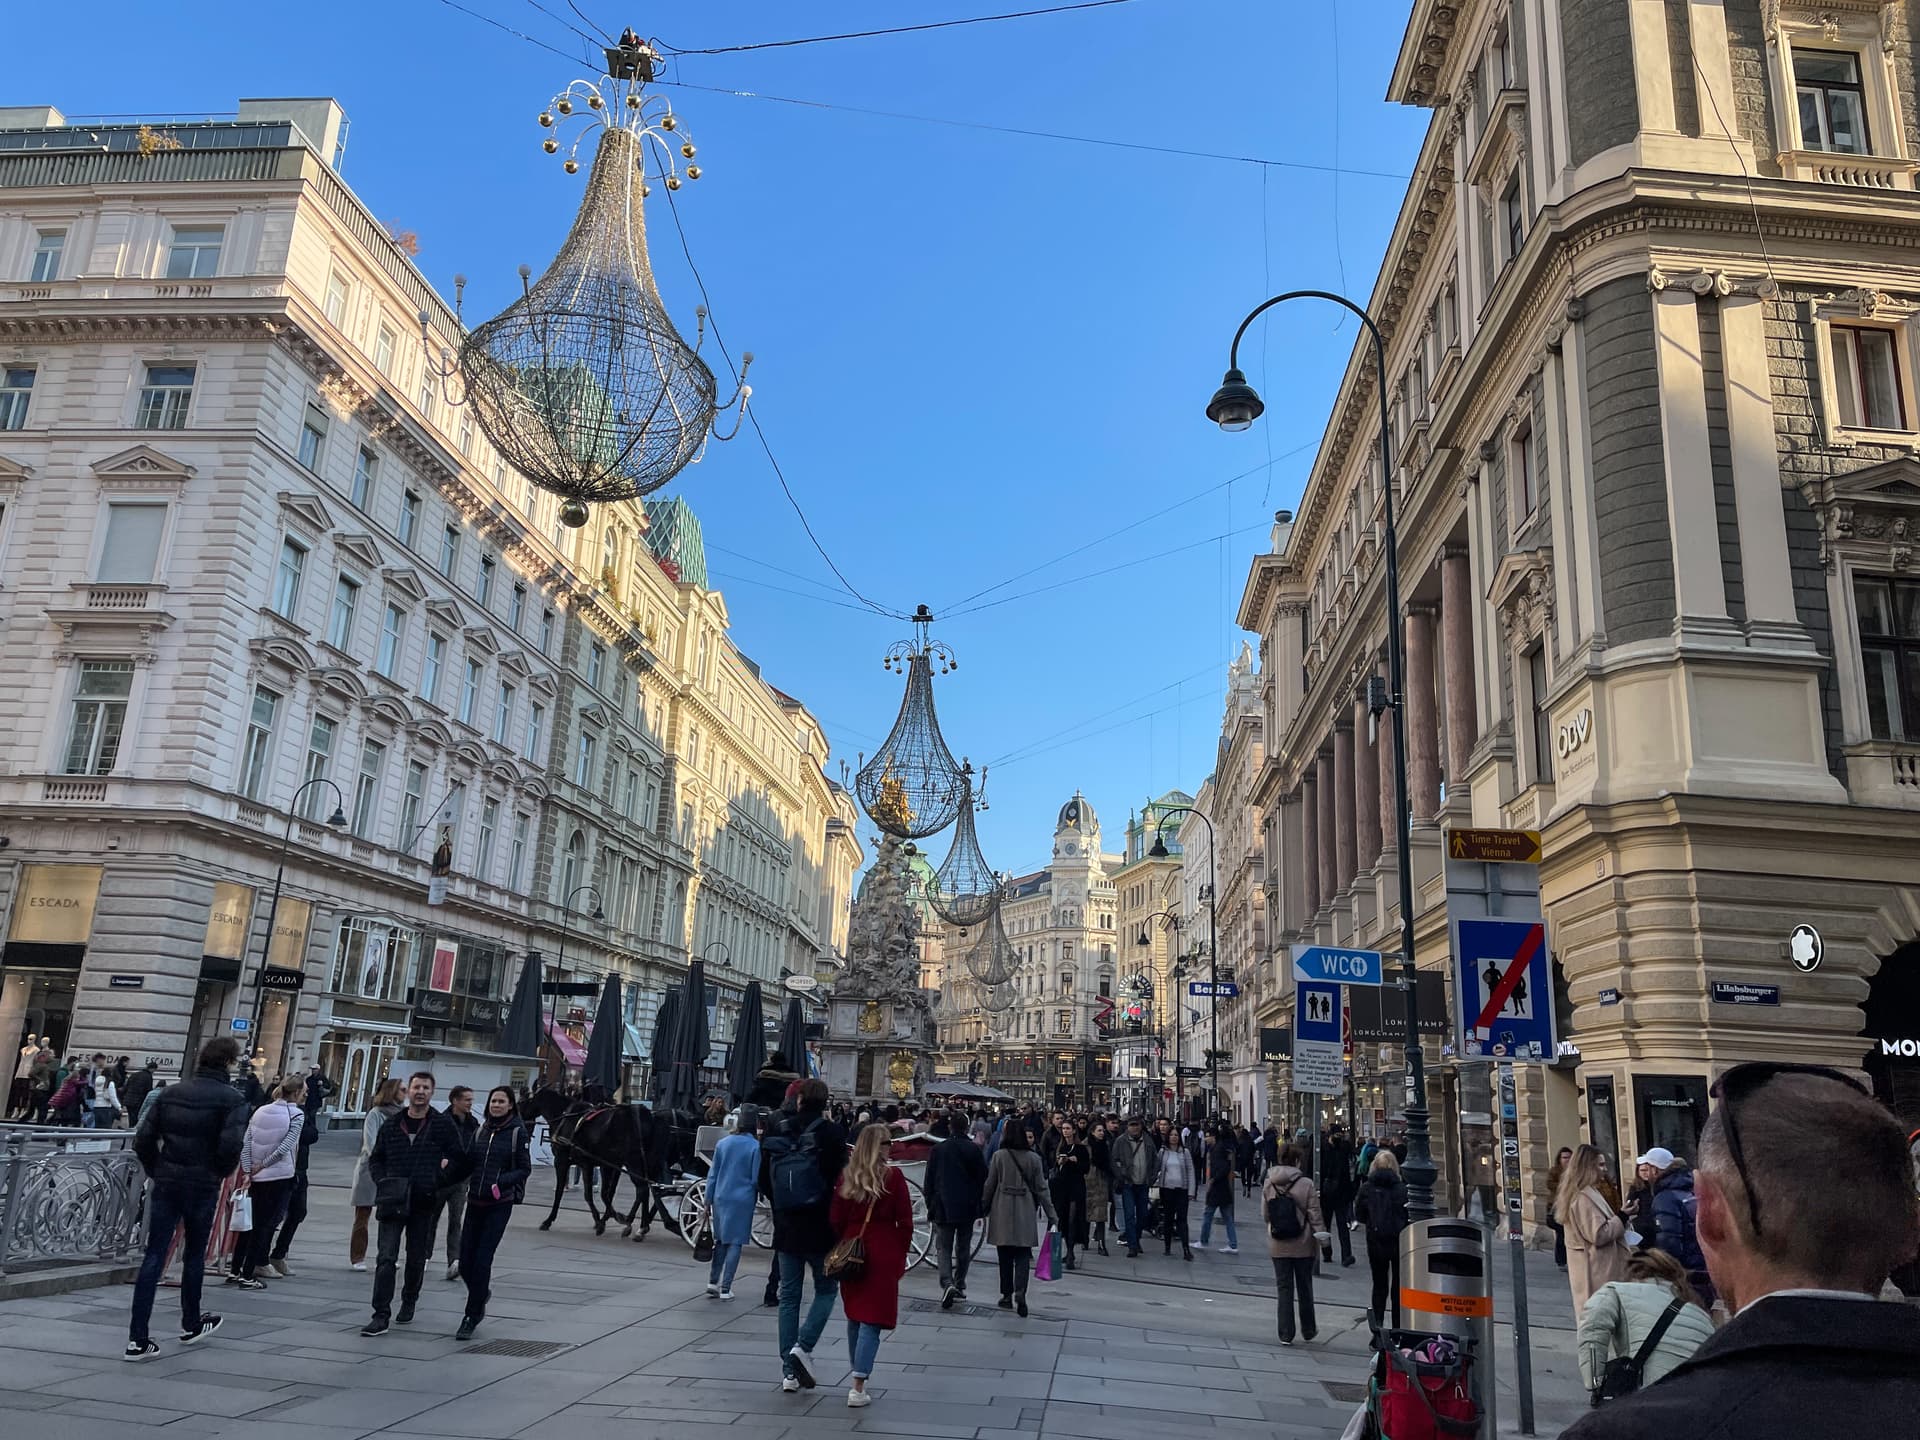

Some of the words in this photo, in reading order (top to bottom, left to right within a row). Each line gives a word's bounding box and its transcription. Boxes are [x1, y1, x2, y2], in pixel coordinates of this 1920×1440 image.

[1471, 834, 1491, 844] Time
[1494, 835, 1520, 845] Travel
[1481, 847, 1511, 857] Vienna
[30, 897, 80, 908] ESCADA
[213, 912, 243, 926] ESCADA
[276, 926, 303, 938] ESCADA
[1321, 953, 1349, 975] WC
[264, 975, 297, 984] SCADA
[1194, 984, 1232, 995] Beritz
[1734, 995, 1759, 1003] gasse
[1385, 1019, 1444, 1028] LONHAMP
[1264, 1052, 1292, 1061] MaxMar
